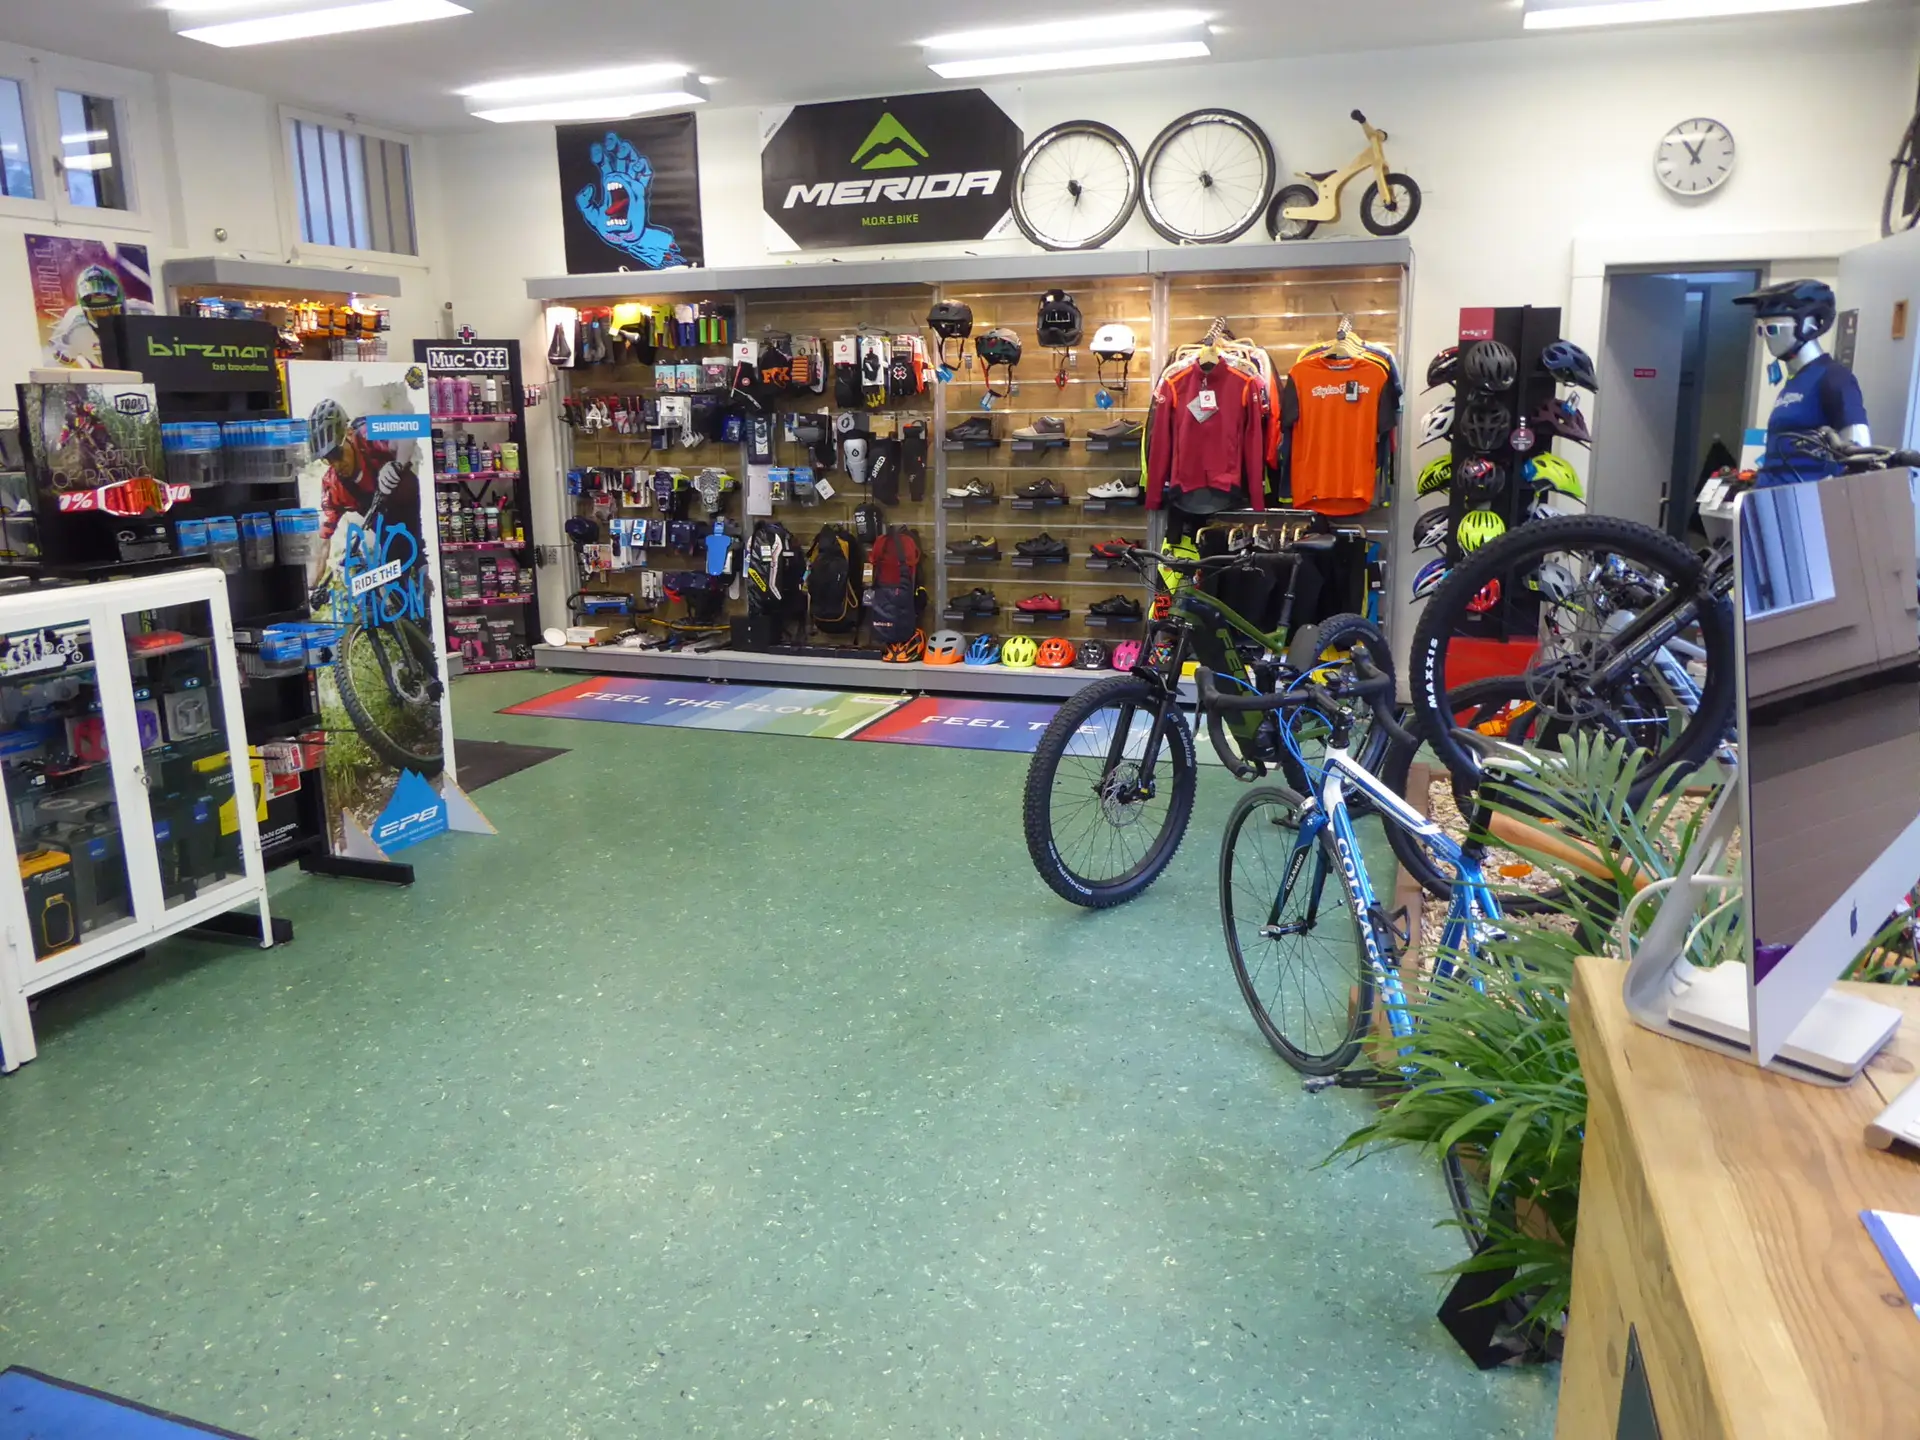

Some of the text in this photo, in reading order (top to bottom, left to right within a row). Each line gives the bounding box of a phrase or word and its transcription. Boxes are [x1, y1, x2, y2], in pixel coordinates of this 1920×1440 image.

[783, 170, 1002, 209] MERIDA
[147, 336, 267, 358] birzman
[228, 363, 269, 371] boundless
[431, 350, 504, 368] Muc-Off
[120, 398, 145, 410] 100%
[372, 421, 419, 432] SHIMANO
[95, 449, 147, 466] SPIRIT
[872, 456, 886, 478] SHRED
[354, 564, 399, 591] RIDE THE
[1425, 638, 1438, 708] MAXXIS
[575, 691, 840, 717] FEEL THE FLOW
[920, 715, 1102, 734] FEEL TE
[380, 805, 438, 838] EP8
[1285, 854, 1304, 890] COLNAGO
[1337, 838, 1386, 983] COLNAGO
